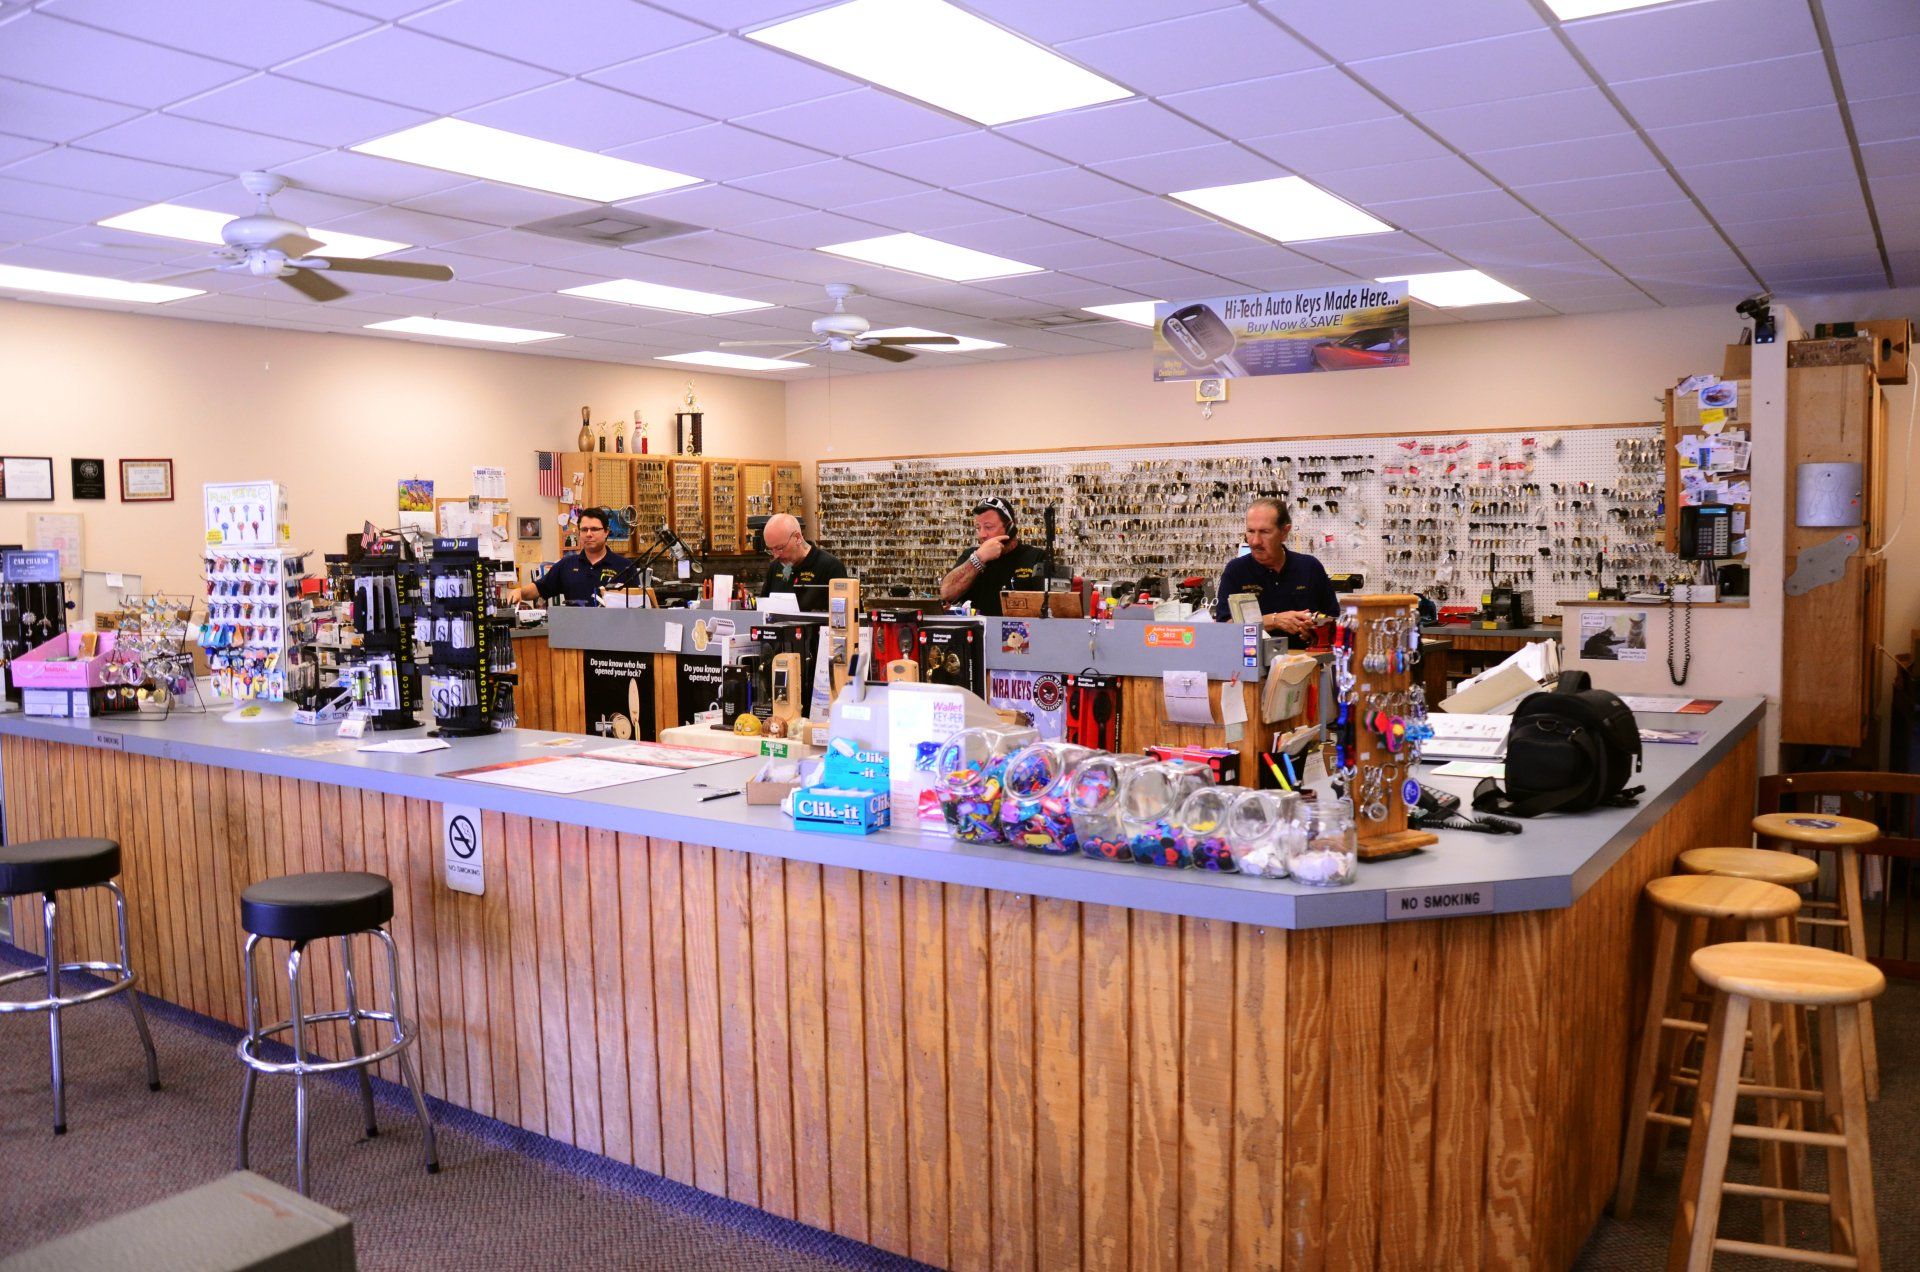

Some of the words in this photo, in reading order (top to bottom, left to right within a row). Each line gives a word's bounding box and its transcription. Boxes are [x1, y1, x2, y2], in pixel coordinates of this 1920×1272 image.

[1225, 299, 1263, 319] Hi-Tech
[1265, 297, 1292, 317] Auto
[1295, 294, 1322, 317] Keys
[1324, 290, 1357, 311] Made
[1360, 288, 1399, 308] Here...
[1247, 321, 1269, 335] Buy
[1271, 319, 1298, 330] Now
[1299, 317, 1308, 329] &
[1310, 314, 1344, 328] SAVE!
[13, 558, 25, 566] CAR
[26, 557, 49, 565] CHARMS
[590, 658, 598, 666] Do
[598, 659, 608, 668] you
[609, 659, 623, 668] know
[624, 660, 635, 669] who
[636, 661, 646, 669] has
[684, 664, 692, 672] Do
[692, 666, 703, 674] you
[704, 665, 721, 673] know
[595, 667, 614, 677] opened
[614, 669, 627, 678] your
[627, 669, 642, 678] lock?
[689, 673, 710, 683] opened
[710, 675, 722, 684] you
[479, 658, 488, 713] DISCOVER
[993, 678, 1009, 699] NRA
[1011, 679, 1032, 701] KEYS
[1033, 675, 1054, 693] NATIONAL
[933, 702, 962, 712] Wallet
[1034, 697, 1063, 711] ASSOCIATION
[855, 752, 884, 764] Clik
[798, 800, 860, 820] Clik-it
[448, 864, 456, 872] NO
[456, 865, 480, 877] SMOKING
[1401, 897, 1418, 910] NO
[1424, 892, 1480, 909] SMOKING
